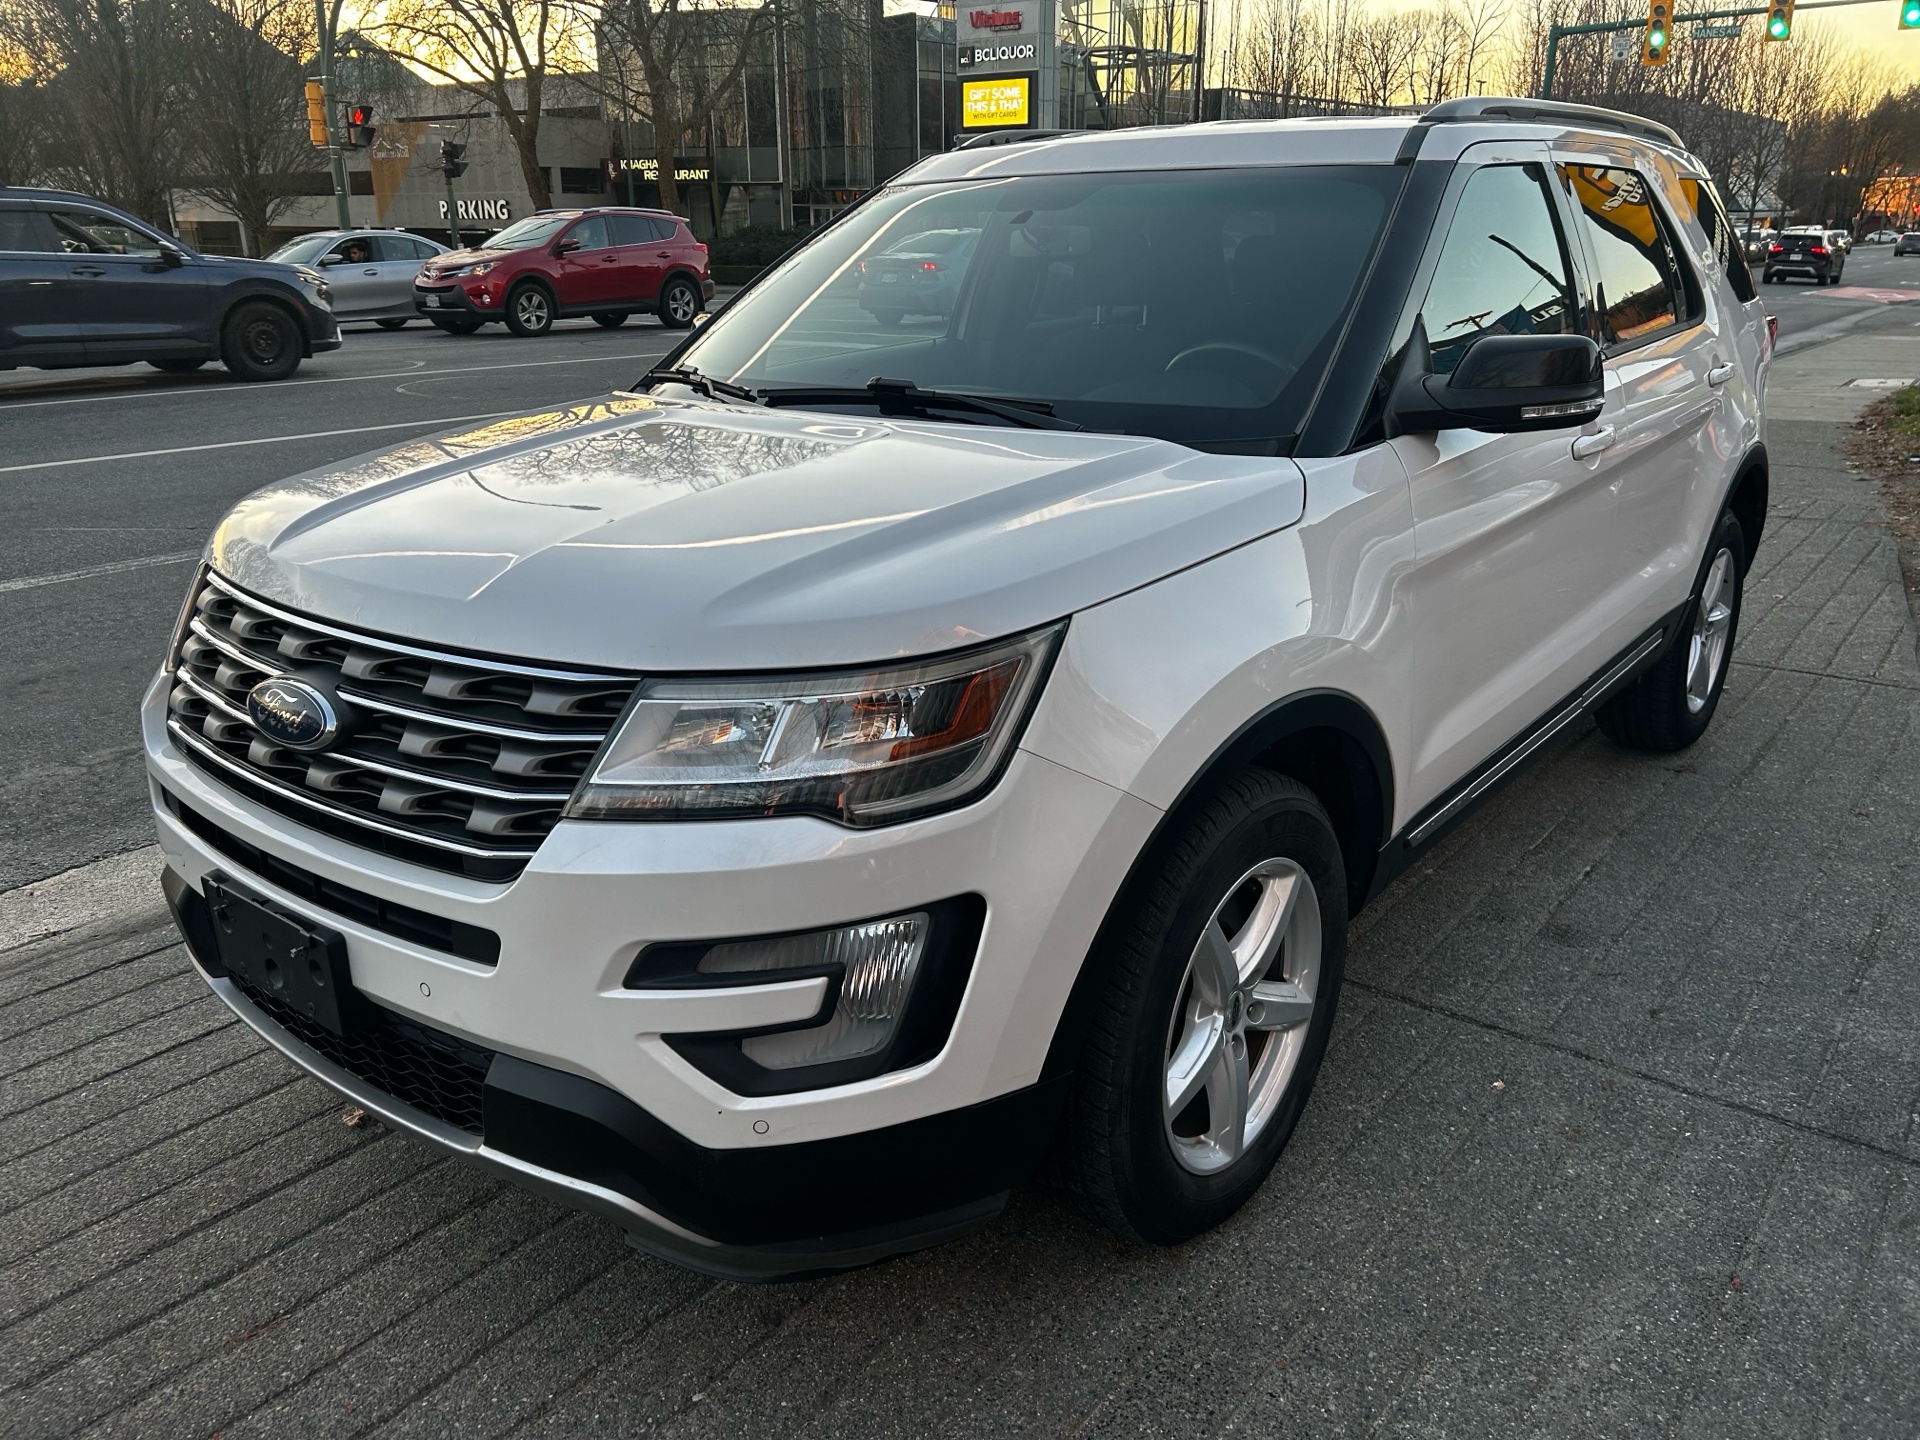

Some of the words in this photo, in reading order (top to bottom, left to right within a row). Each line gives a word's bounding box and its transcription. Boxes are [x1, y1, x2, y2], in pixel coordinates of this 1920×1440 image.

[969, 9, 1021, 28] Visions
[1692, 28, 1725, 38] HANES
[969, 88, 990, 101] GIFT
[991, 87, 1021, 99] SOME
[966, 101, 988, 113] THIS
[990, 100, 997, 112] &
[998, 99, 1024, 110] THAT
[620, 159, 658, 170] KAGHA
[439, 199, 508, 220] PRKING
[256, 687, 308, 734] Ford
